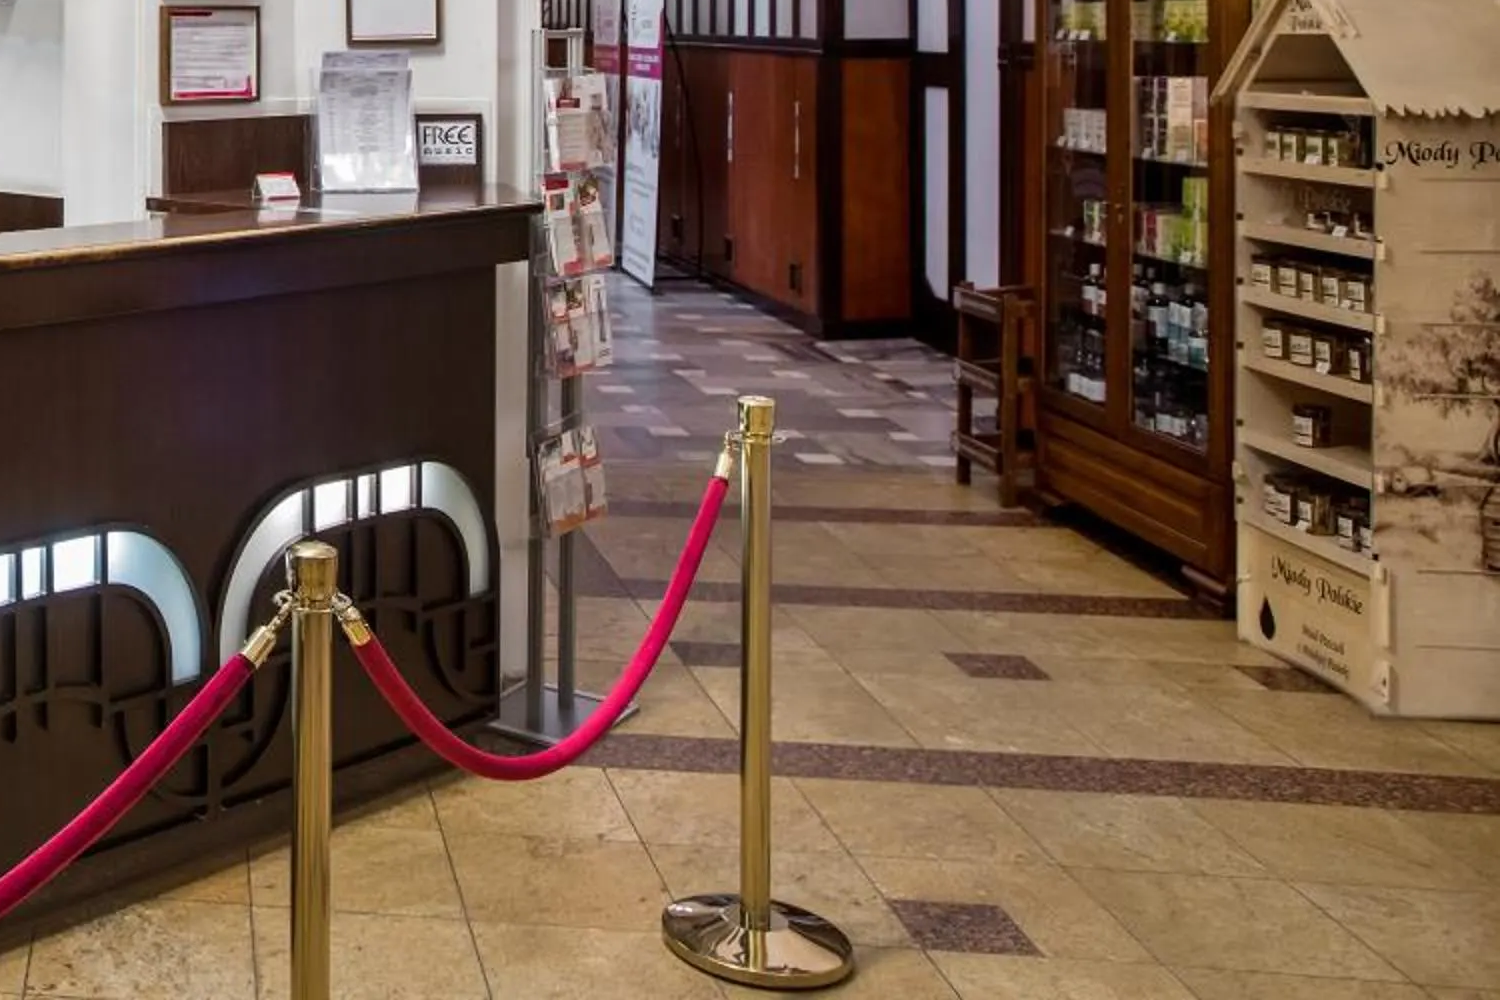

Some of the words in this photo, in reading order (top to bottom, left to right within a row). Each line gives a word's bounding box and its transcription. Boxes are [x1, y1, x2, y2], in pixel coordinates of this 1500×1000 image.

[422, 125, 473, 145] FREE
[423, 146, 473, 155] music
[1385, 139, 1460, 169] Miody
[1271, 554, 1312, 596] Miody
[1315, 576, 1364, 615] Polskie
